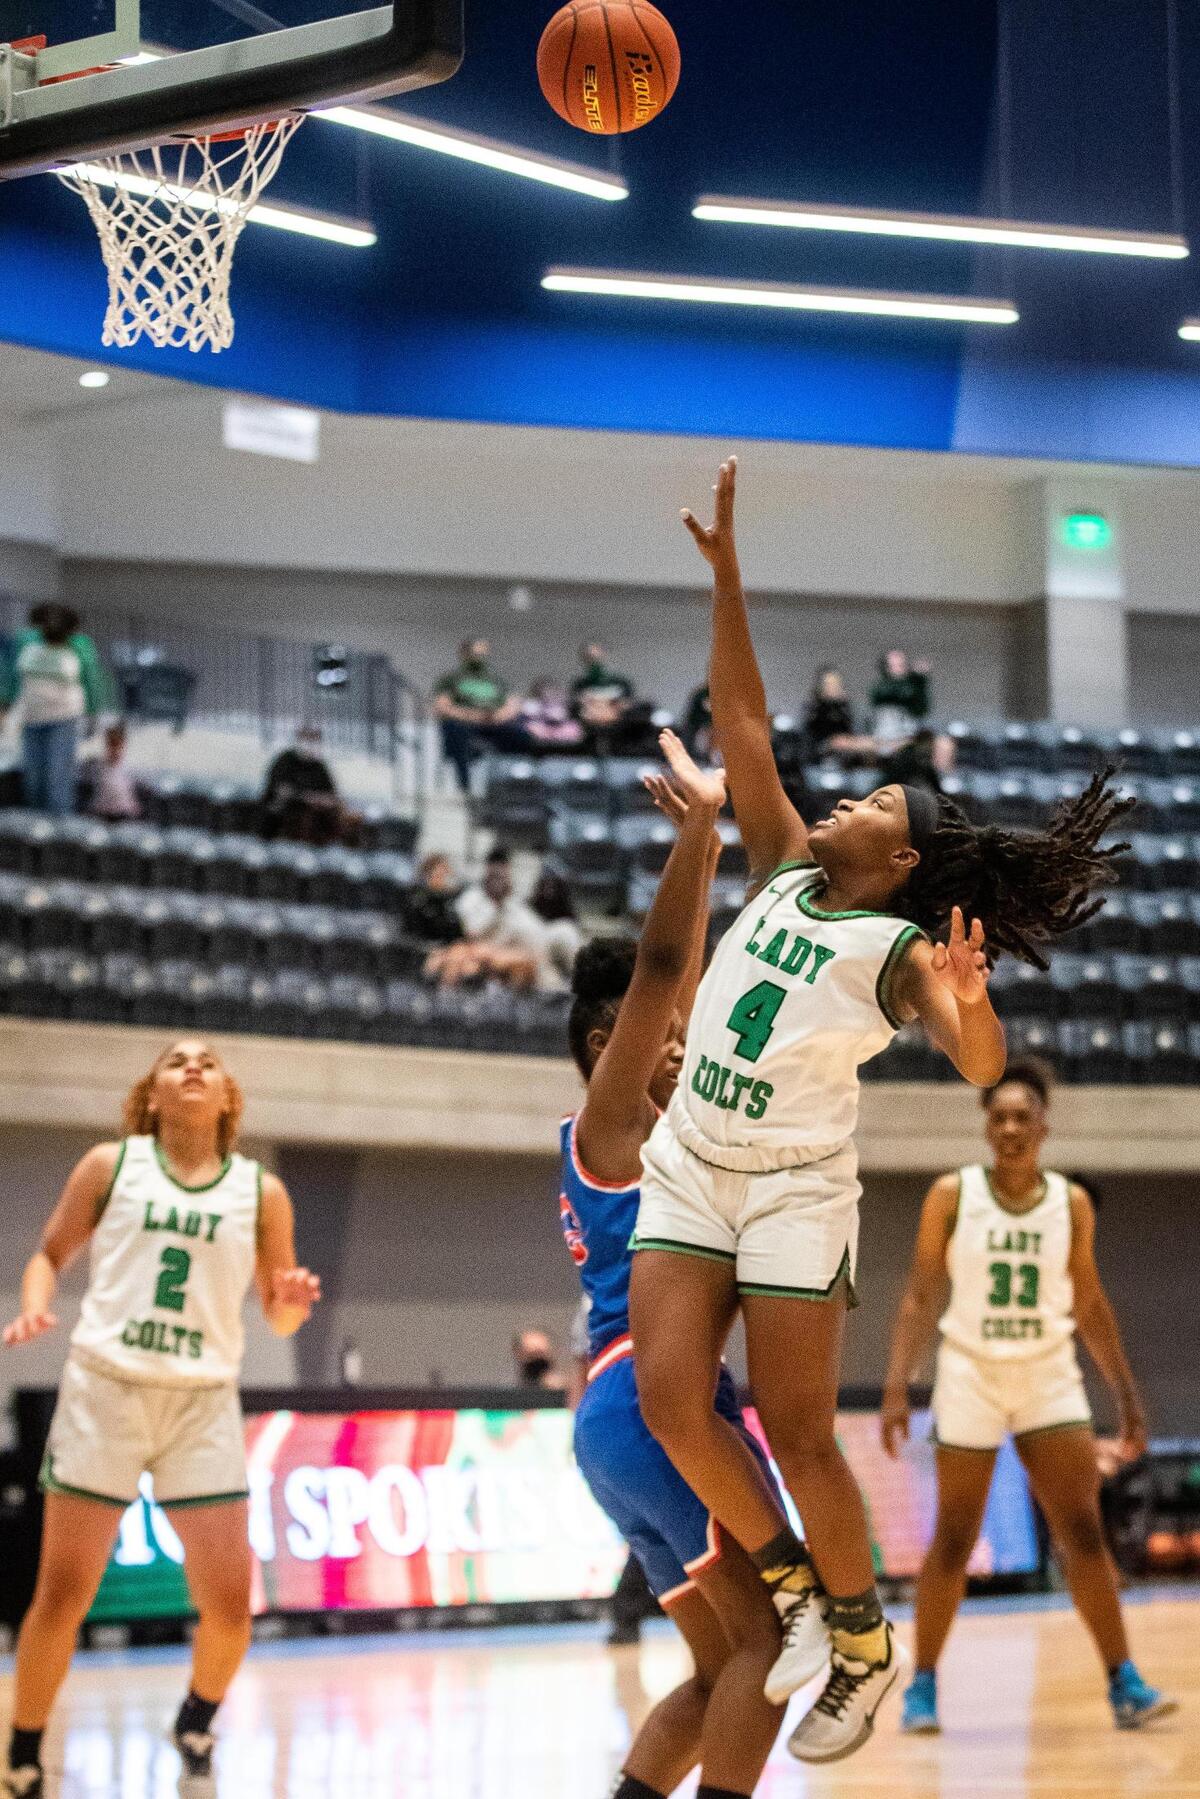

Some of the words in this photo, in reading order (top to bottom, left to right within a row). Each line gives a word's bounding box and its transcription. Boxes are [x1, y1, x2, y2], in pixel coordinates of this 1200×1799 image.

[584, 64, 604, 130] ELITE
[745, 915, 836, 985] LADY
[726, 979, 788, 1064] 4
[691, 1054, 775, 1121] COLTS
[143, 1200, 223, 1244] LADY
[154, 1246, 191, 1313] 2
[988, 1261, 1039, 1308] 33
[121, 1318, 204, 1359] COLTS
